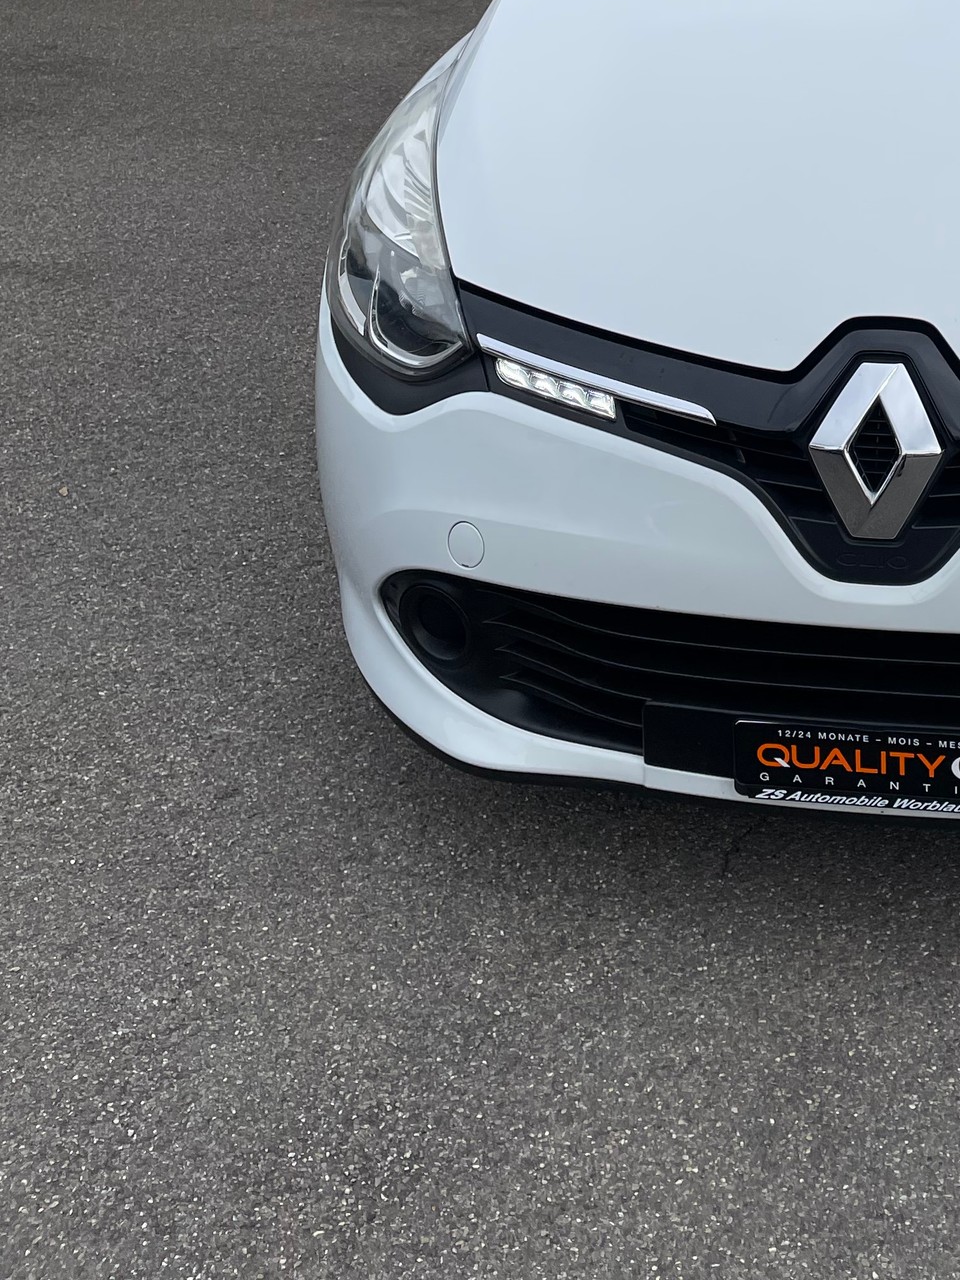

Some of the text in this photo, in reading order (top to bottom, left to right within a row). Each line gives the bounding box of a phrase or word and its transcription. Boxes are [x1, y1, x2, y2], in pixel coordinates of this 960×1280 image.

[778, 730, 811, 738] 12/24
[818, 732, 869, 742] MONATE
[888, 737, 920, 746] MOIS
[757, 743, 946, 778] QUALITY
[755, 788, 787, 799] ZS
[786, 790, 889, 807] Automobile
